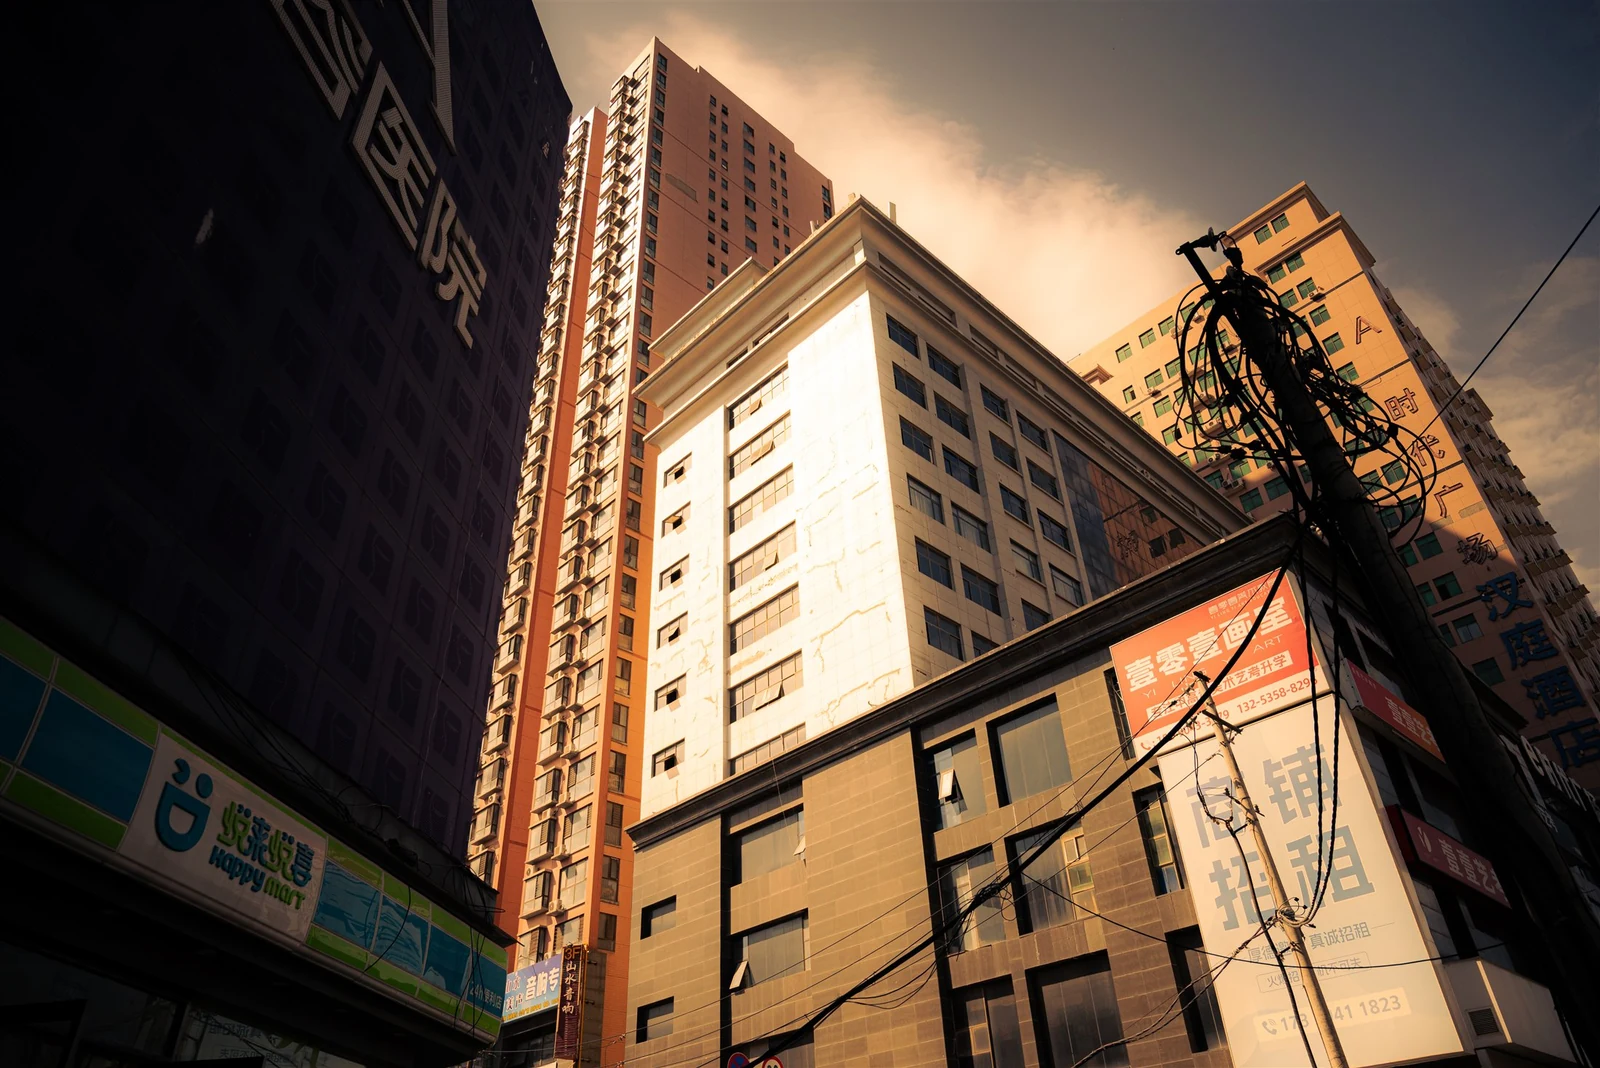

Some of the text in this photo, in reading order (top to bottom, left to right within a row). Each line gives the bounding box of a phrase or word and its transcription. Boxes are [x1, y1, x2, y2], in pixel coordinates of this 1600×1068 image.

[1253, 634, 1283, 654] ART
[1475, 571, 1600, 771] 汉庭酒店
[1186, 742, 1342, 848] 商铺
[209, 845, 266, 892] Happy
[1209, 825, 1375, 931] 招租
[565, 948, 580, 960] 3F
[1309, 922, 1371, 950] 真诚招租
[562, 961, 577, 1014] 山水音响
[1360, 995, 1401, 1016] 1823
